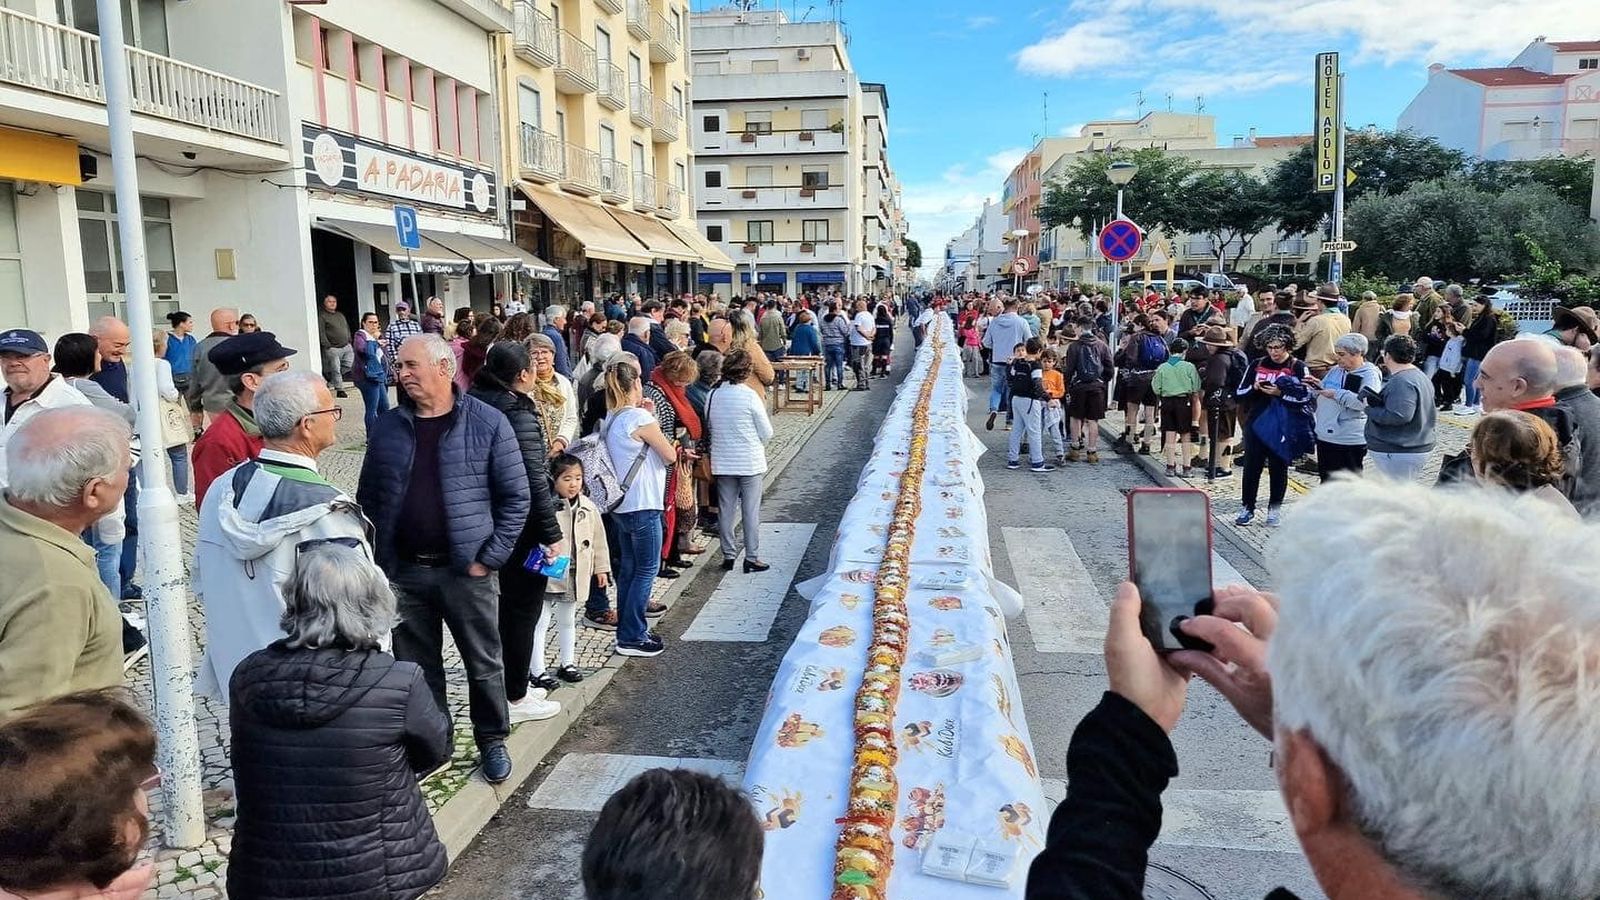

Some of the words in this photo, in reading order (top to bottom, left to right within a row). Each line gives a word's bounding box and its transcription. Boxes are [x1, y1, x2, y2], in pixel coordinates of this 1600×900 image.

[1324, 55, 1333, 109] HOTEL
[1323, 116, 1332, 170] APOLO
[363, 156, 381, 186] A
[386, 160, 461, 201] PADARIA
[400, 210, 413, 243] P
[1324, 242, 1352, 251] PISCINA
